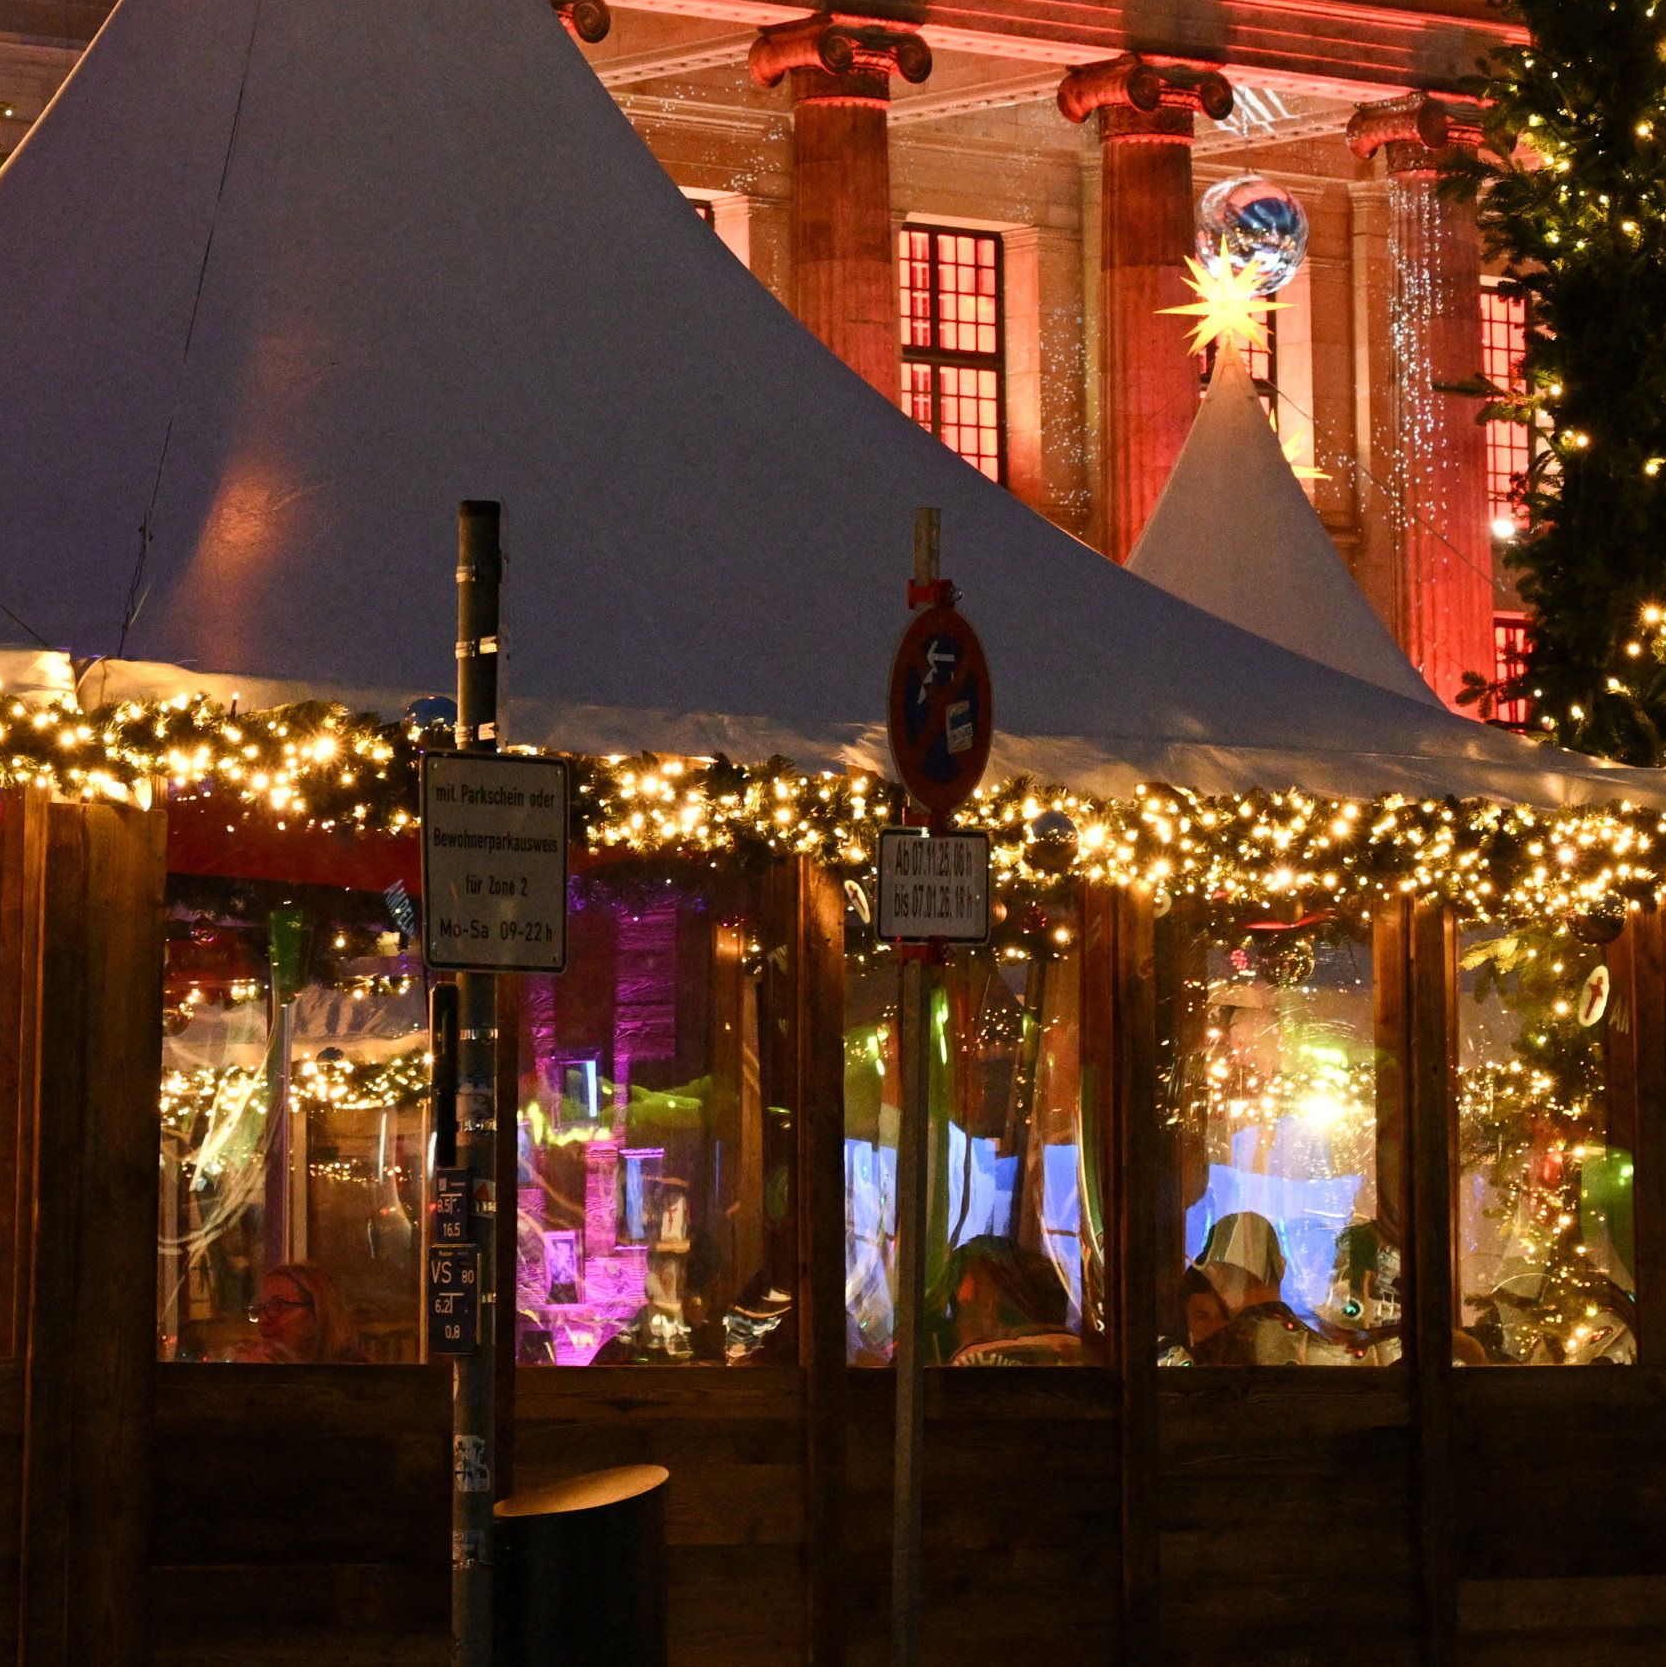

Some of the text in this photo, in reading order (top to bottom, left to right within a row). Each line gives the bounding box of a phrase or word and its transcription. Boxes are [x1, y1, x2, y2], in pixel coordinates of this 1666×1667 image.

[436, 783, 555, 808] mit Parkschein oder
[433, 827, 558, 854] Bewohnerparkausweis
[895, 840, 909, 875] Ab
[466, 874, 528, 897] für Zone 2
[895, 883, 908, 917] bis
[440, 917, 489, 939] Mo-Sa
[431, 1261, 475, 1284] VS 80
